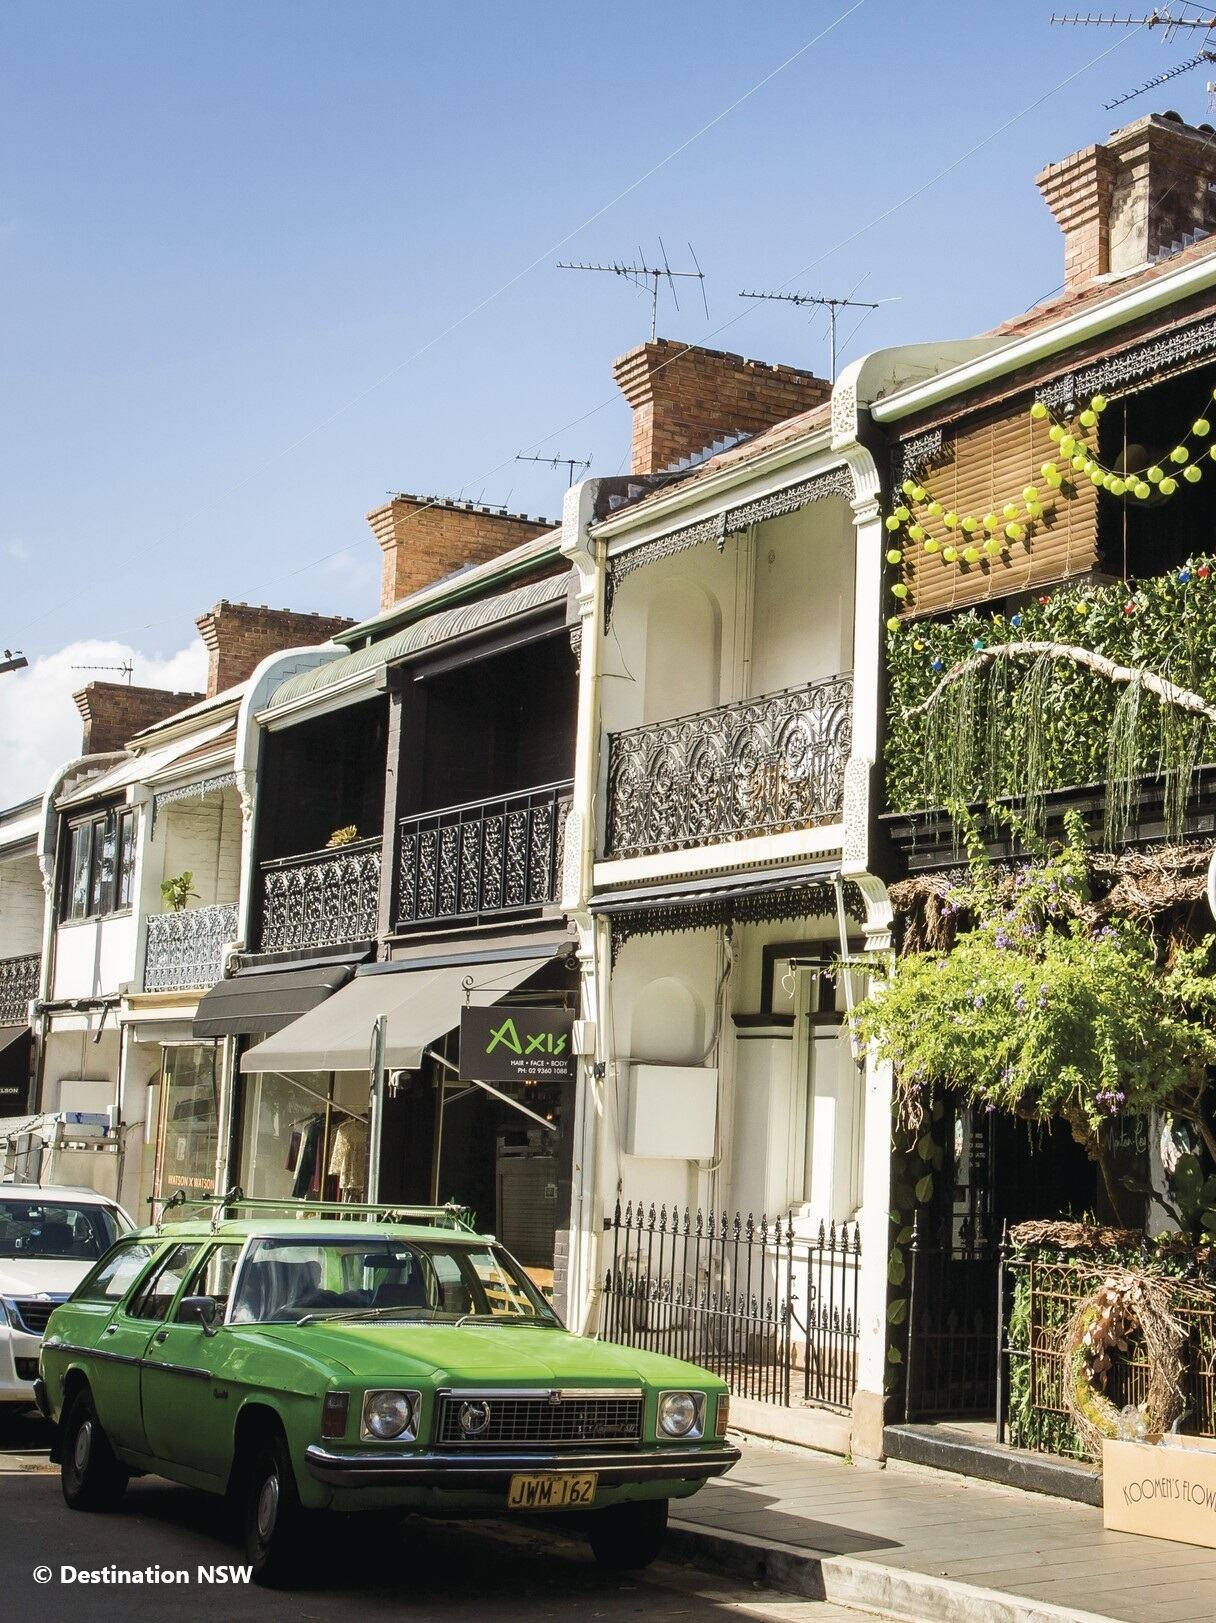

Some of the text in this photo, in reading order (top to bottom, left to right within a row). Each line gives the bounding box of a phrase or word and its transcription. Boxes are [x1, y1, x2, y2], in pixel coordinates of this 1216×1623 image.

[553, 1067, 568, 1075] 1088
[0, 1086, 19, 1094] LSON
[167, 1175, 216, 1190] WATSON X WATSON
[1122, 1477, 1180, 1506] KOOMEN'S
